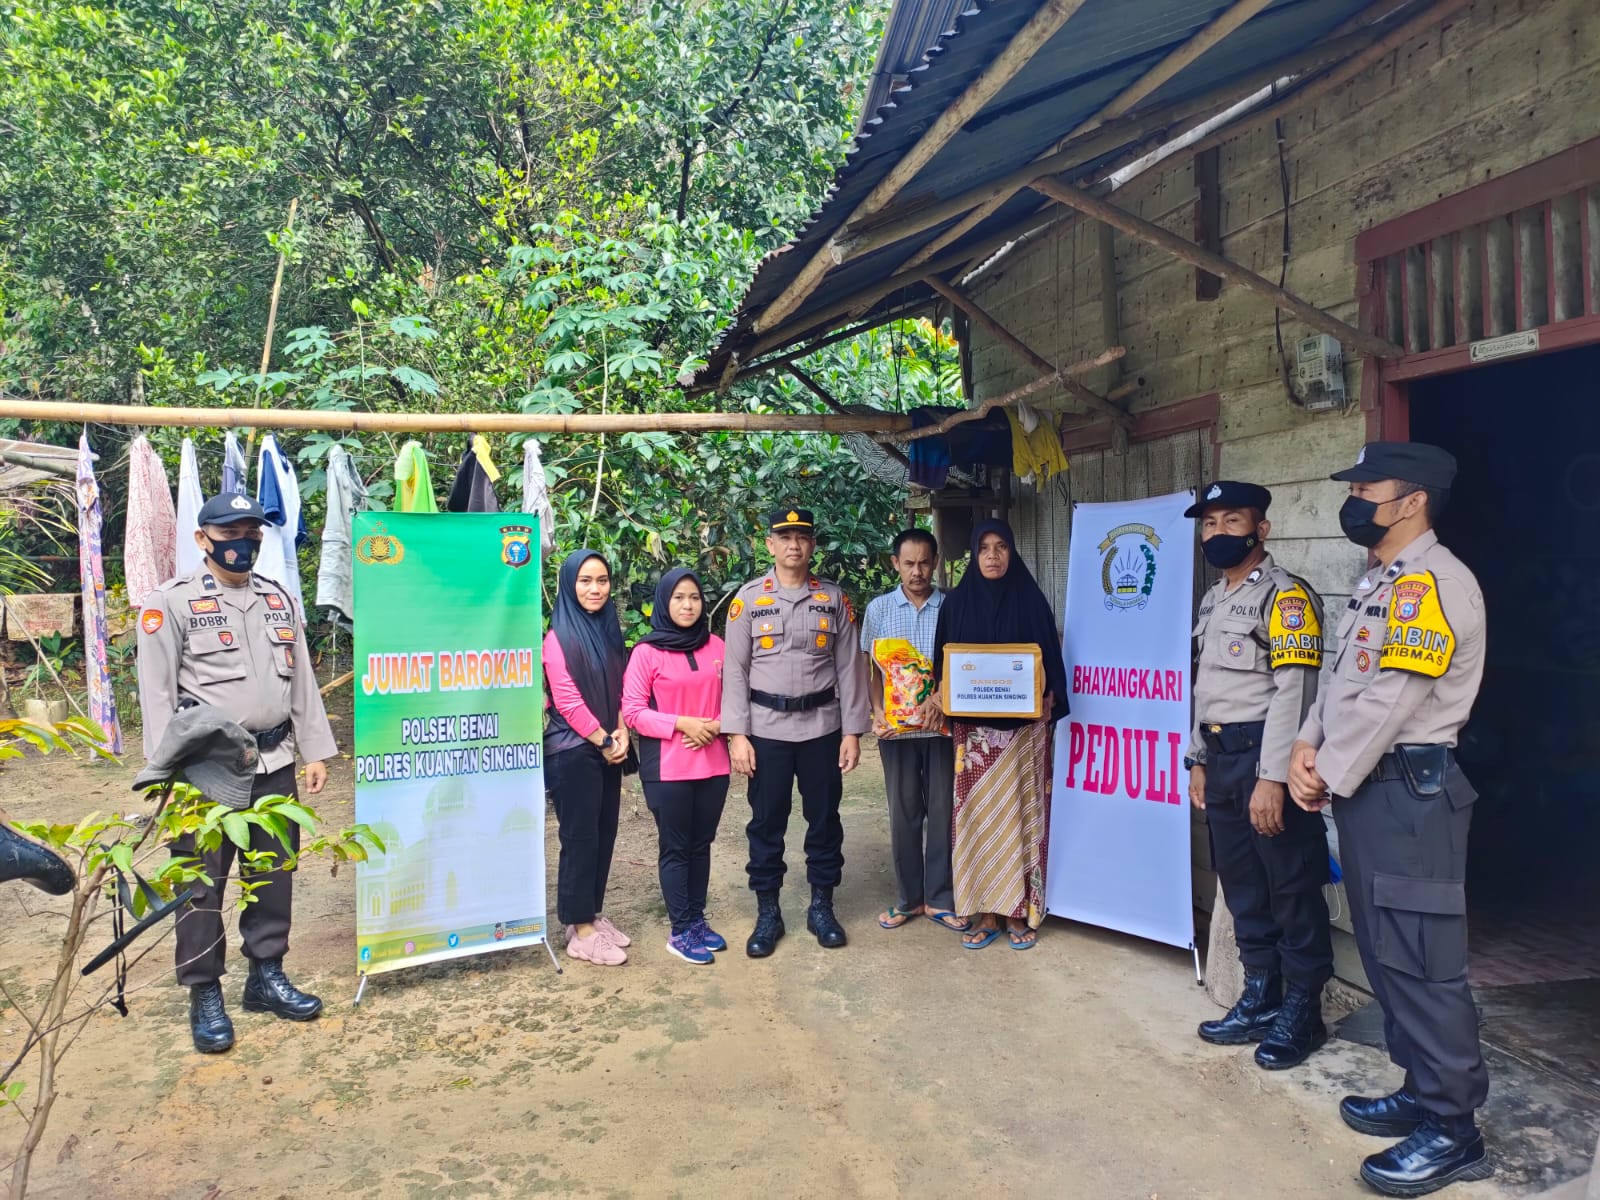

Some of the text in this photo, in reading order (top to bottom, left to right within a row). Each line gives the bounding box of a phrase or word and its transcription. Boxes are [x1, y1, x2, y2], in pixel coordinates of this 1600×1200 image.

[190, 615, 228, 629] BOBBY
[1230, 605, 1257, 616] POLRI
[361, 648, 533, 695] JUMAT BAROKAH
[1073, 665, 1183, 702] BHAYANGKARI
[402, 712, 498, 744] POLSEK BENAI
[356, 742, 541, 782] POLRES KUANTAN SINGINGI
[1066, 722, 1181, 806] PEDULI
